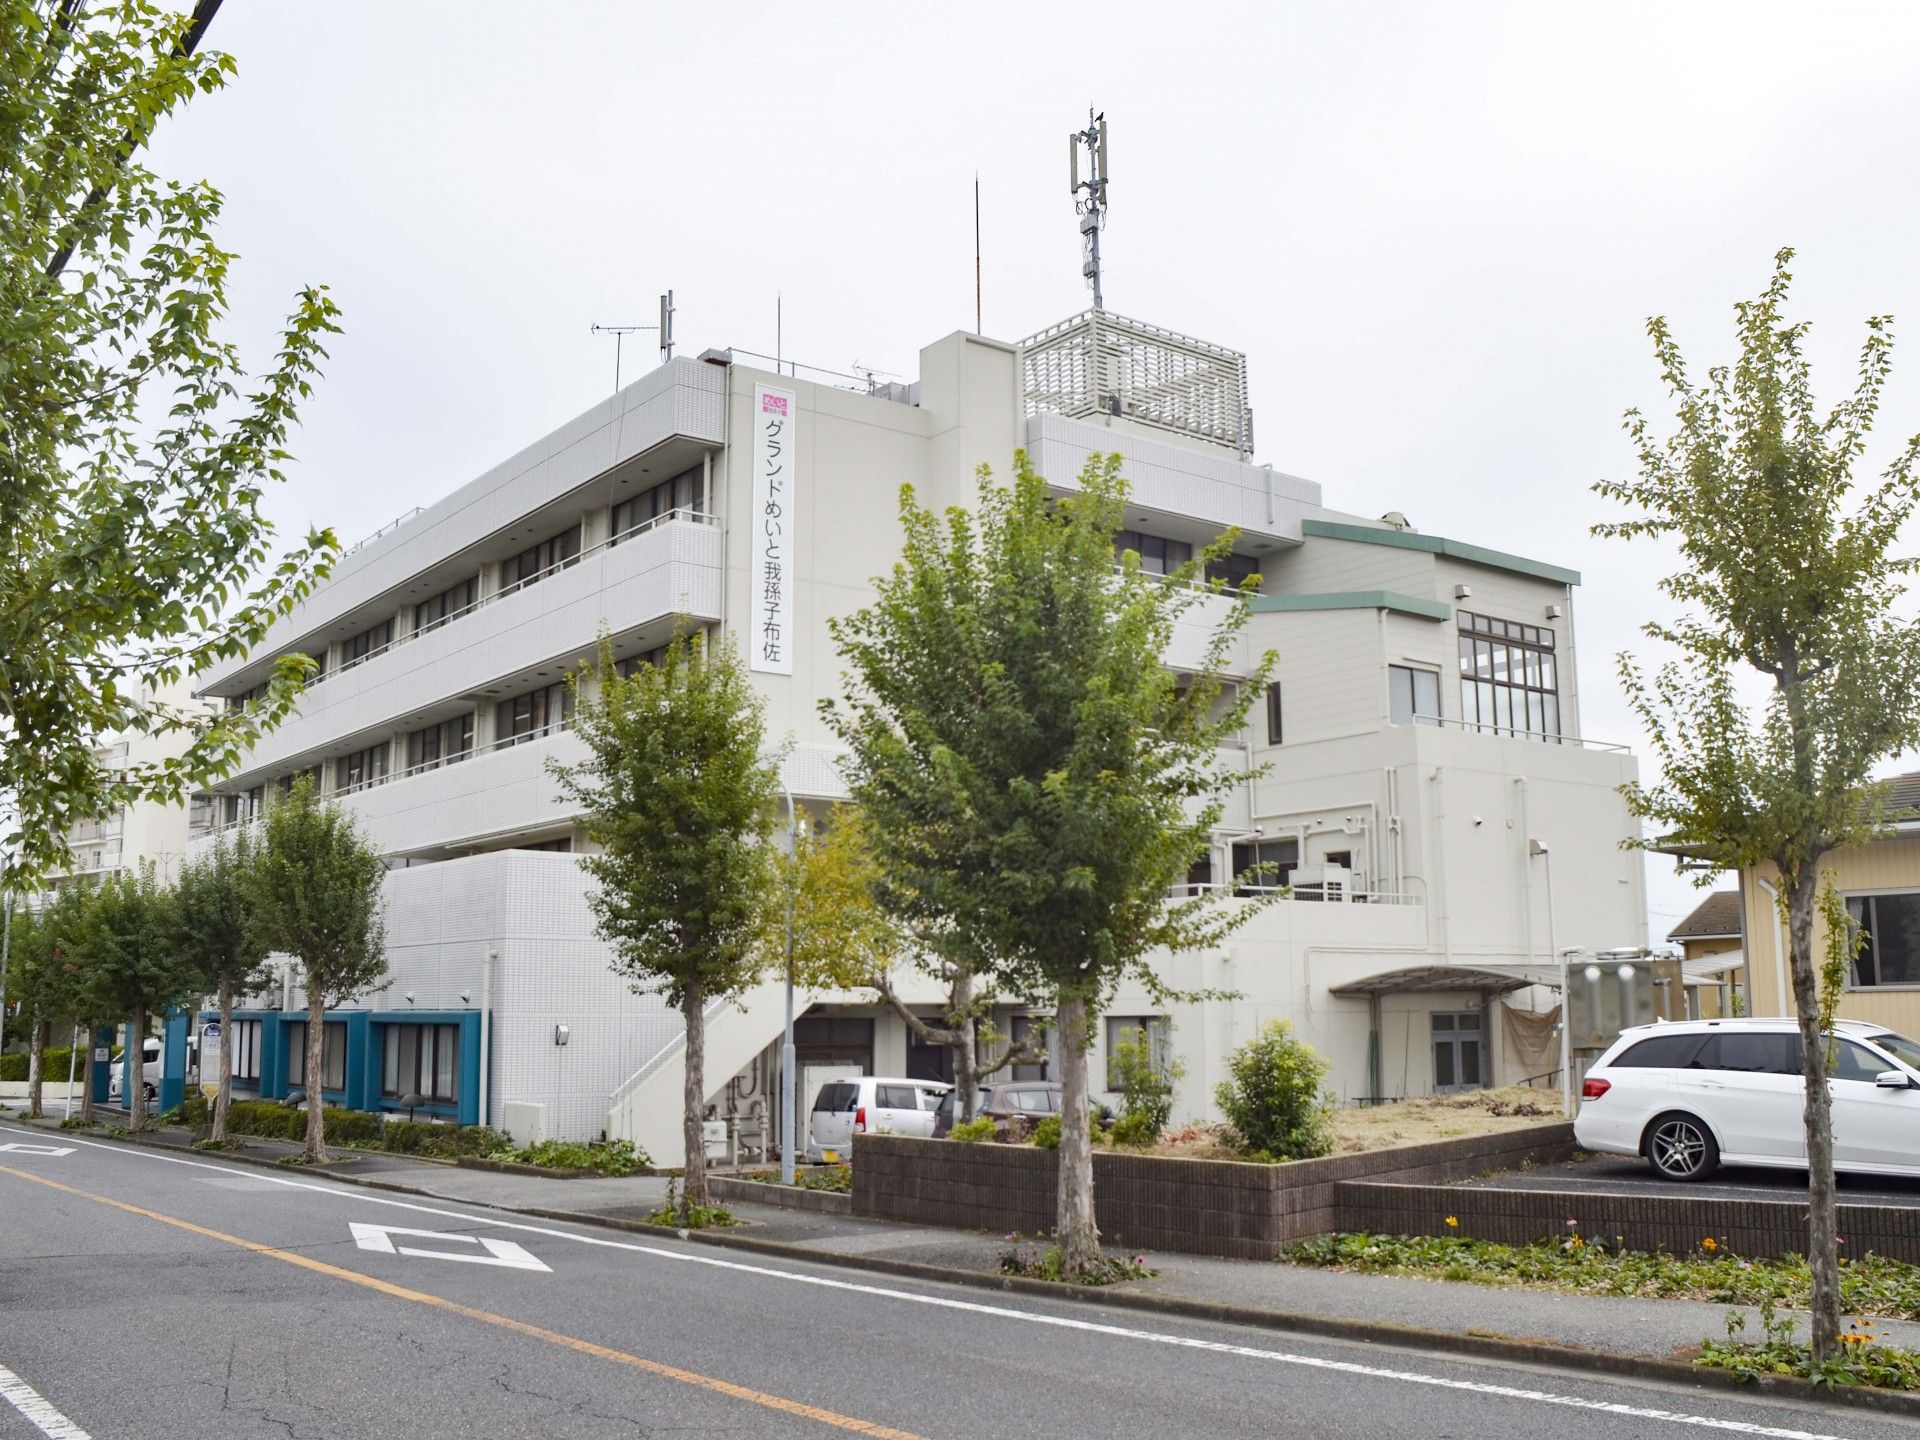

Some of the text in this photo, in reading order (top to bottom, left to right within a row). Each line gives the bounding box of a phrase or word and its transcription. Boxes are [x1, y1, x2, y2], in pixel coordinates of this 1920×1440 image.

[763, 420, 783, 662] グランドめいと我孫子布佐
